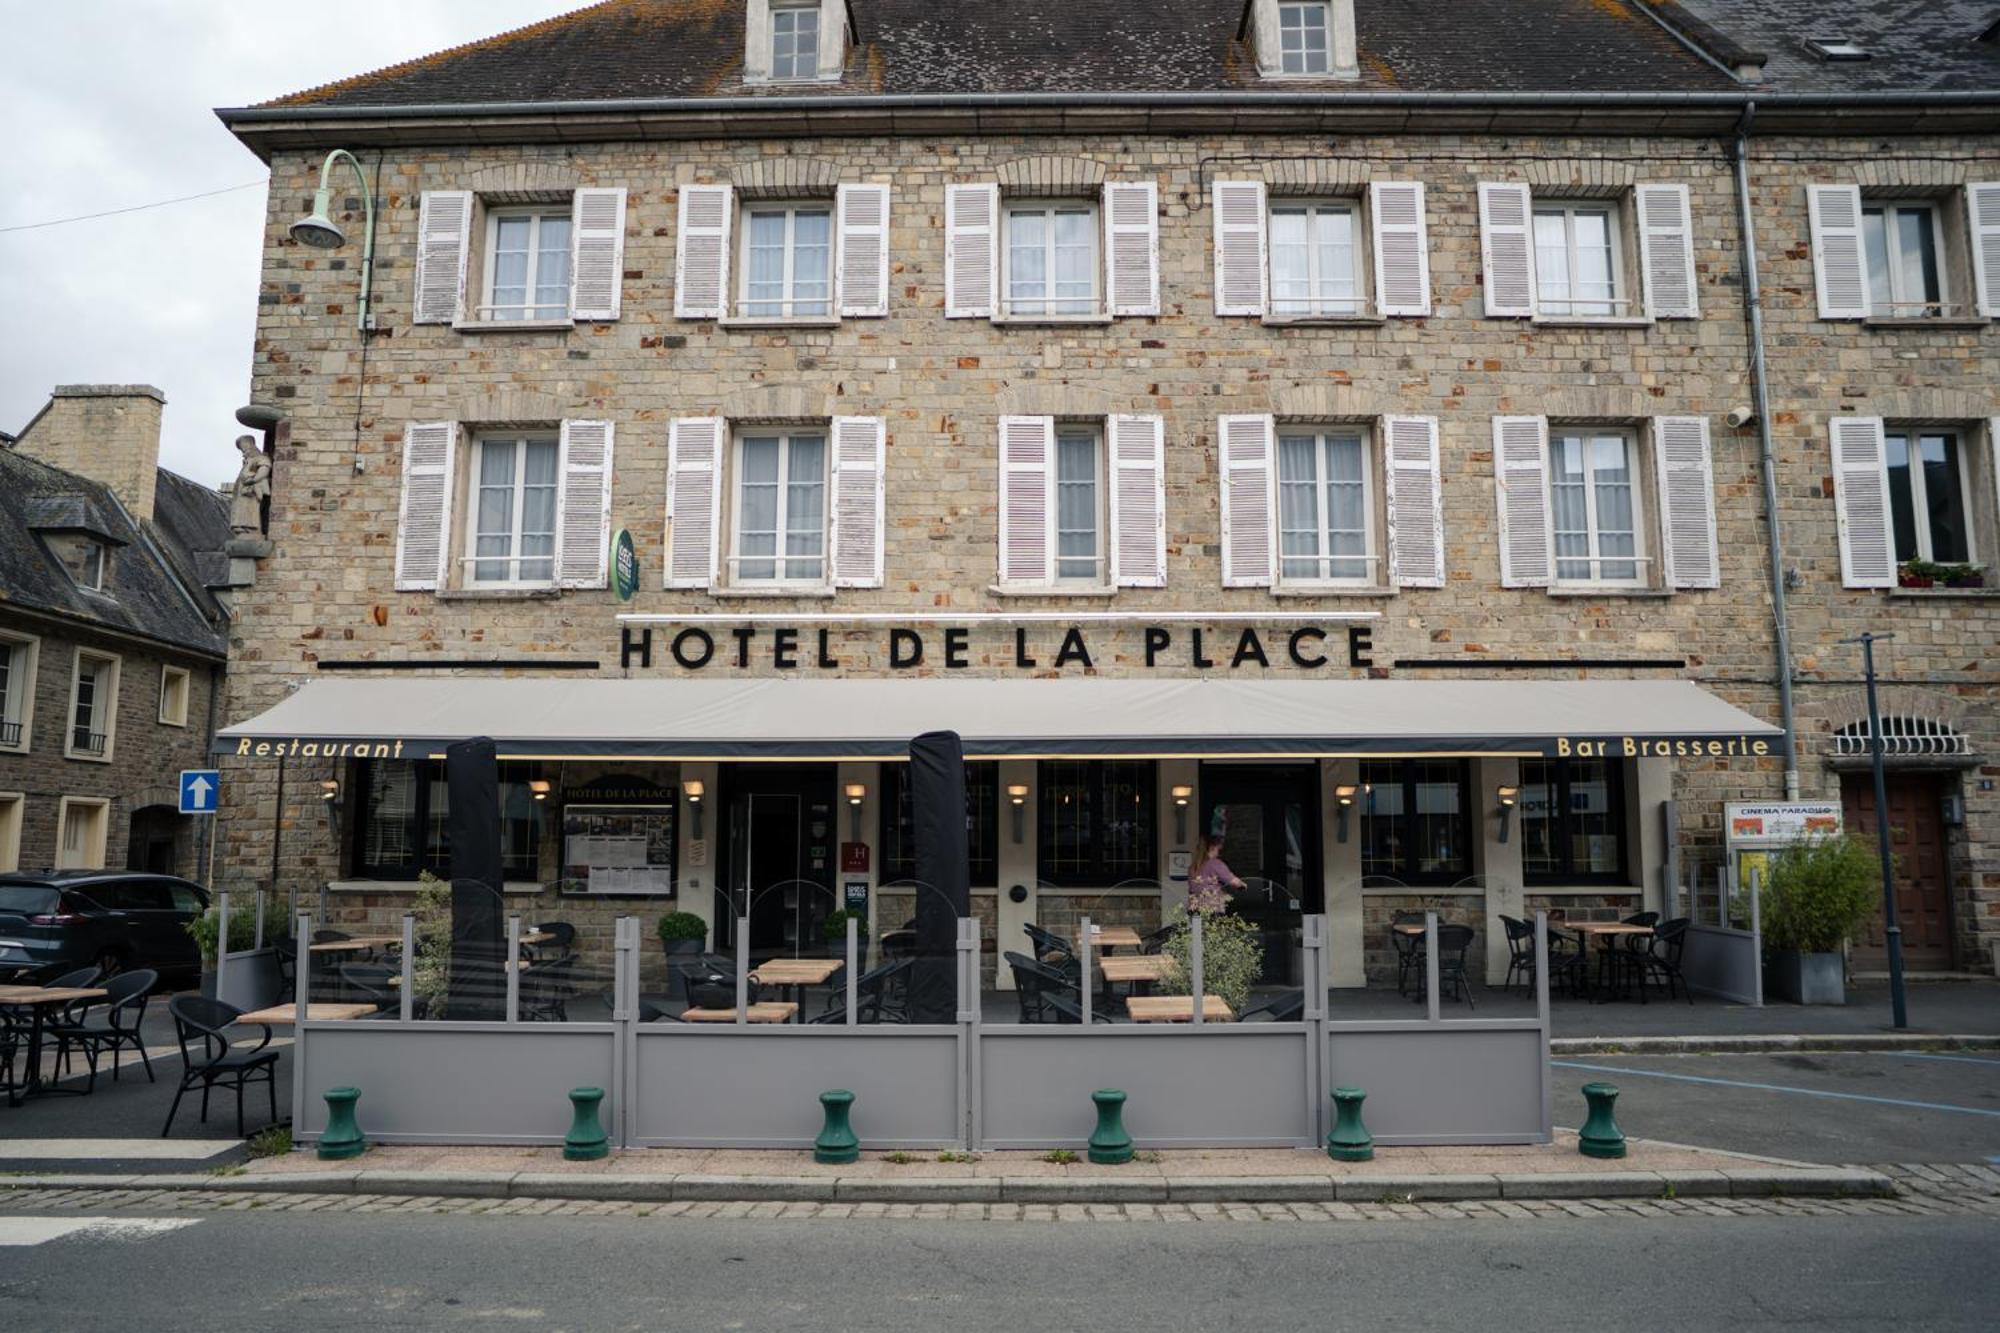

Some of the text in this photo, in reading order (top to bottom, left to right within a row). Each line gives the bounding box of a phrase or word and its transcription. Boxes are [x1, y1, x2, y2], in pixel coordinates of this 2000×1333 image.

[621, 627, 1373, 669] HOTEL DE LA PLACE
[236, 738, 404, 758] Restaurant
[1557, 736, 1769, 757] Bar Brasserie
[1741, 808, 1779, 816] CINEMA
[855, 847, 865, 859] H
